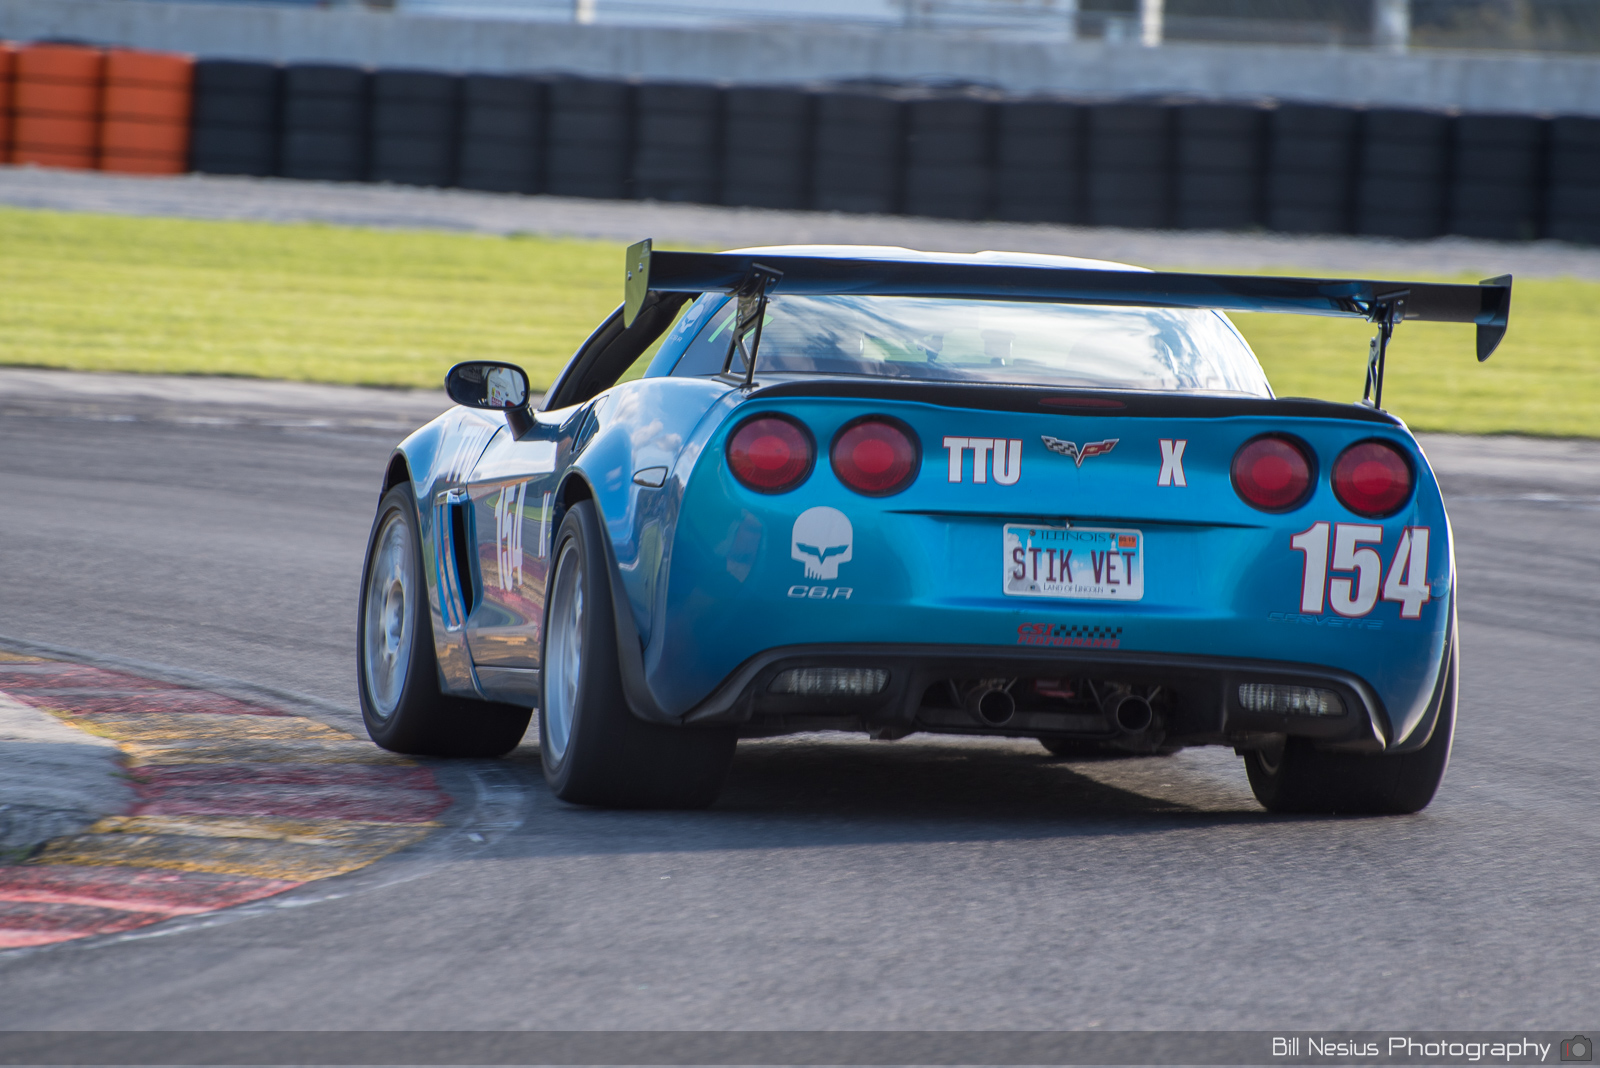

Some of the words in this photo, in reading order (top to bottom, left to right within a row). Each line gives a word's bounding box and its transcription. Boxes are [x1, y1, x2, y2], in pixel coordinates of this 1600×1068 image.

[943, 436, 1023, 486] TTU
[1157, 438, 1188, 487] X
[495, 481, 527, 593] 154
[1041, 530, 1106, 543] ILLINOIS
[1012, 547, 1073, 583] STIK
[1091, 550, 1136, 585] VET
[1289, 520, 1431, 620] 154
[1017, 622, 1056, 636] CSI
[1267, 611, 1385, 631] CORVETTE
[1017, 633, 1121, 649] PERFORMANCE
